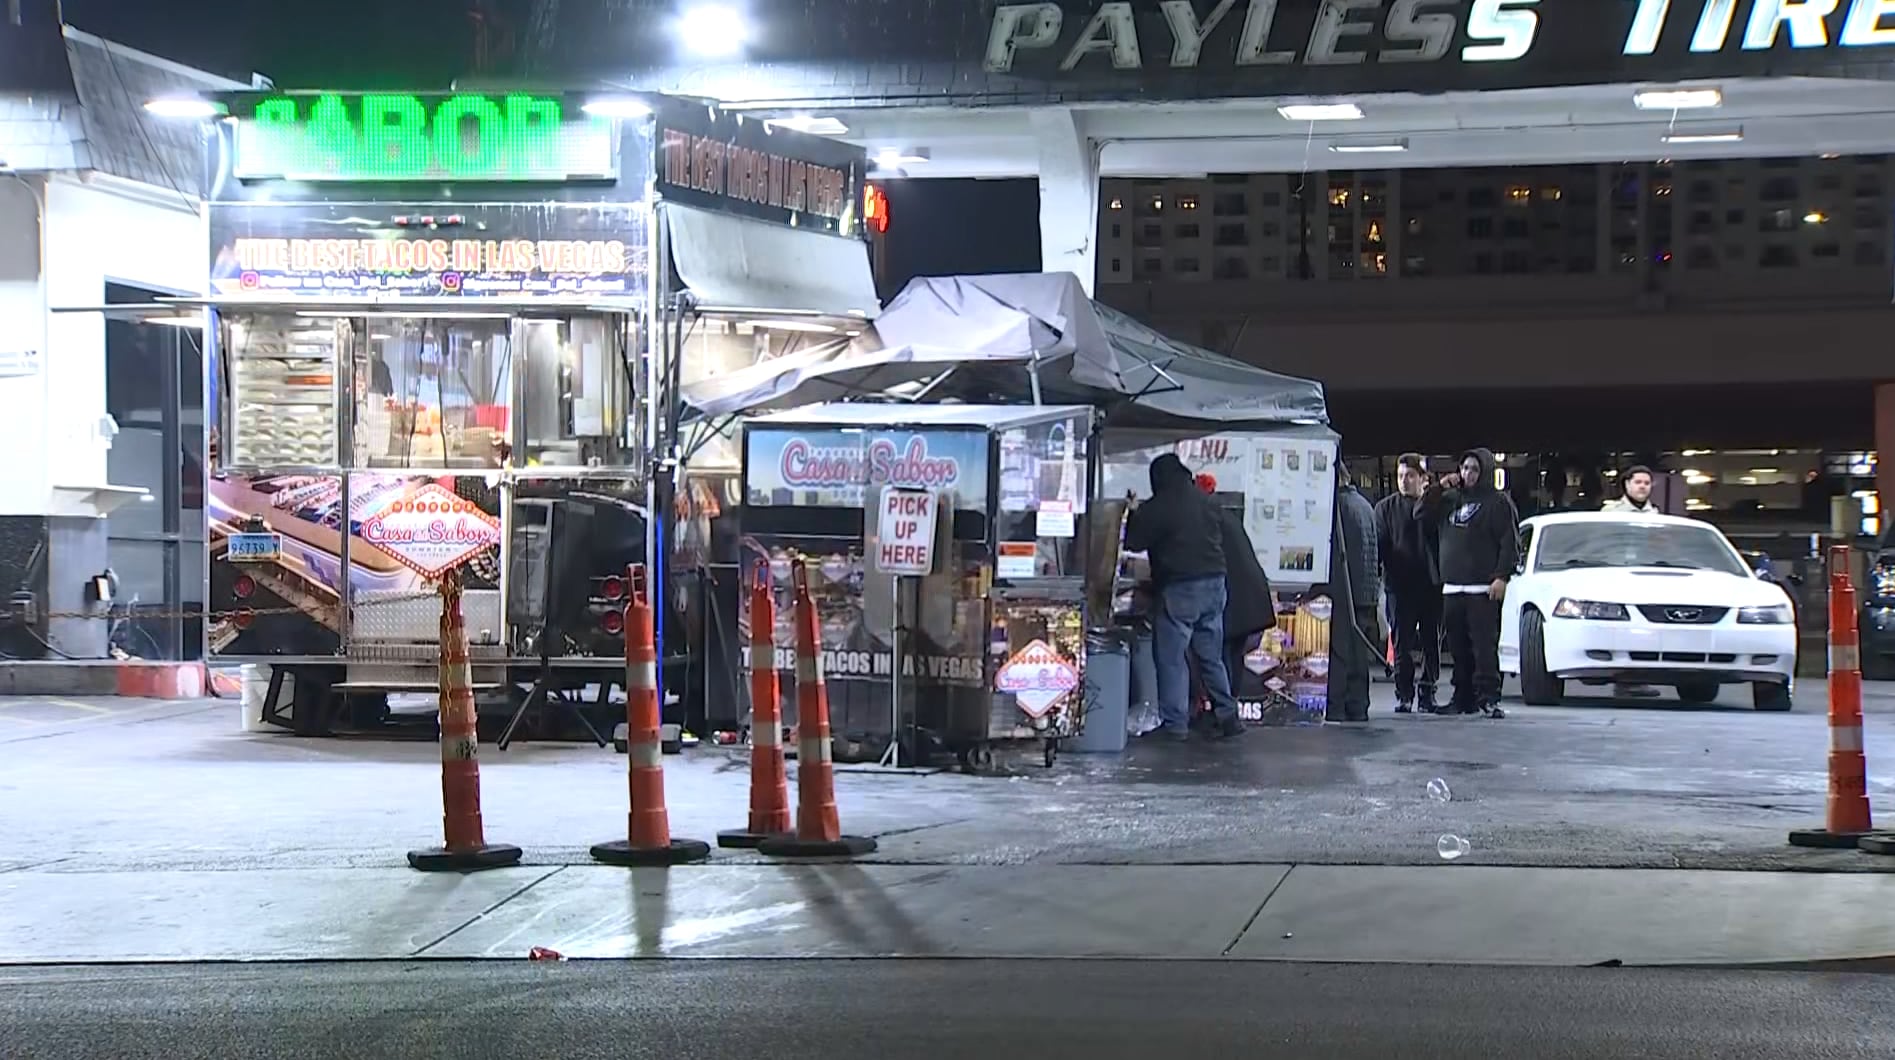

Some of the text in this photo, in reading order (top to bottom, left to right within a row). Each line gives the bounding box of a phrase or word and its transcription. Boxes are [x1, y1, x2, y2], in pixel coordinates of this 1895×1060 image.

[984, 0, 1540, 72] PAYLESS
[255, 92, 562, 177] SABOR
[664, 128, 690, 188] THE
[691, 135, 725, 195] BEST
[726, 143, 768, 203] TACOS
[768, 154, 783, 208] IN
[783, 158, 806, 212] LAS
[807, 164, 845, 219] VEGAS
[236, 239, 625, 273] THE BEST TACOS IN LAS VEGAS
[784, 439, 848, 483] Casa
[869, 436, 958, 483] Sabor
[888, 496, 928, 516] PICK
[367, 519, 412, 542] Casa
[429, 518, 491, 542] Sabor
[895, 520, 917, 539] UP
[882, 546, 926, 565] HERE
[818, 651, 870, 674] TACOS
[874, 655, 890, 675] IN
[928, 657, 984, 679] VEGAS
